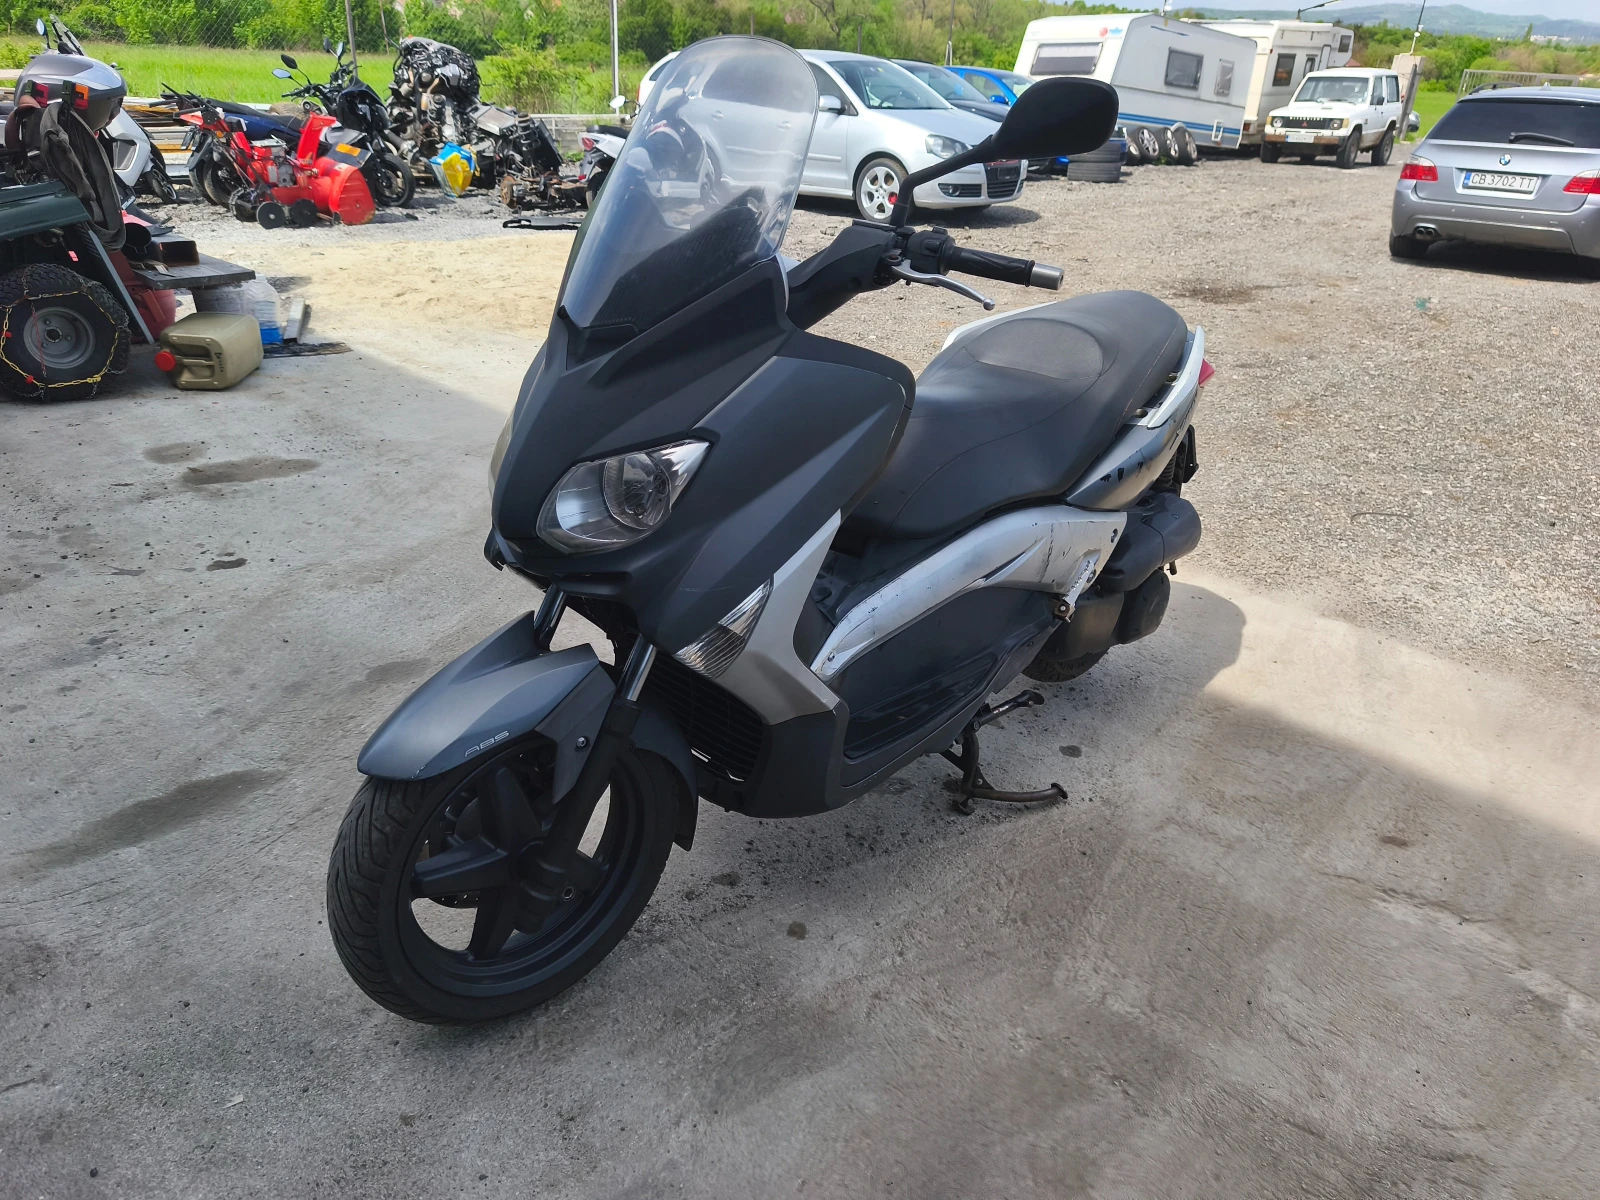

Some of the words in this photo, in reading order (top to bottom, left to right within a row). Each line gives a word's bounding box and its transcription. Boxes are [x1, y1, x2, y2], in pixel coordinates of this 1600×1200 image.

[1471, 173, 1486, 185] CB
[1488, 174, 1517, 188] 3702
[1519, 176, 1534, 188] TT
[464, 730, 509, 757] ABS
